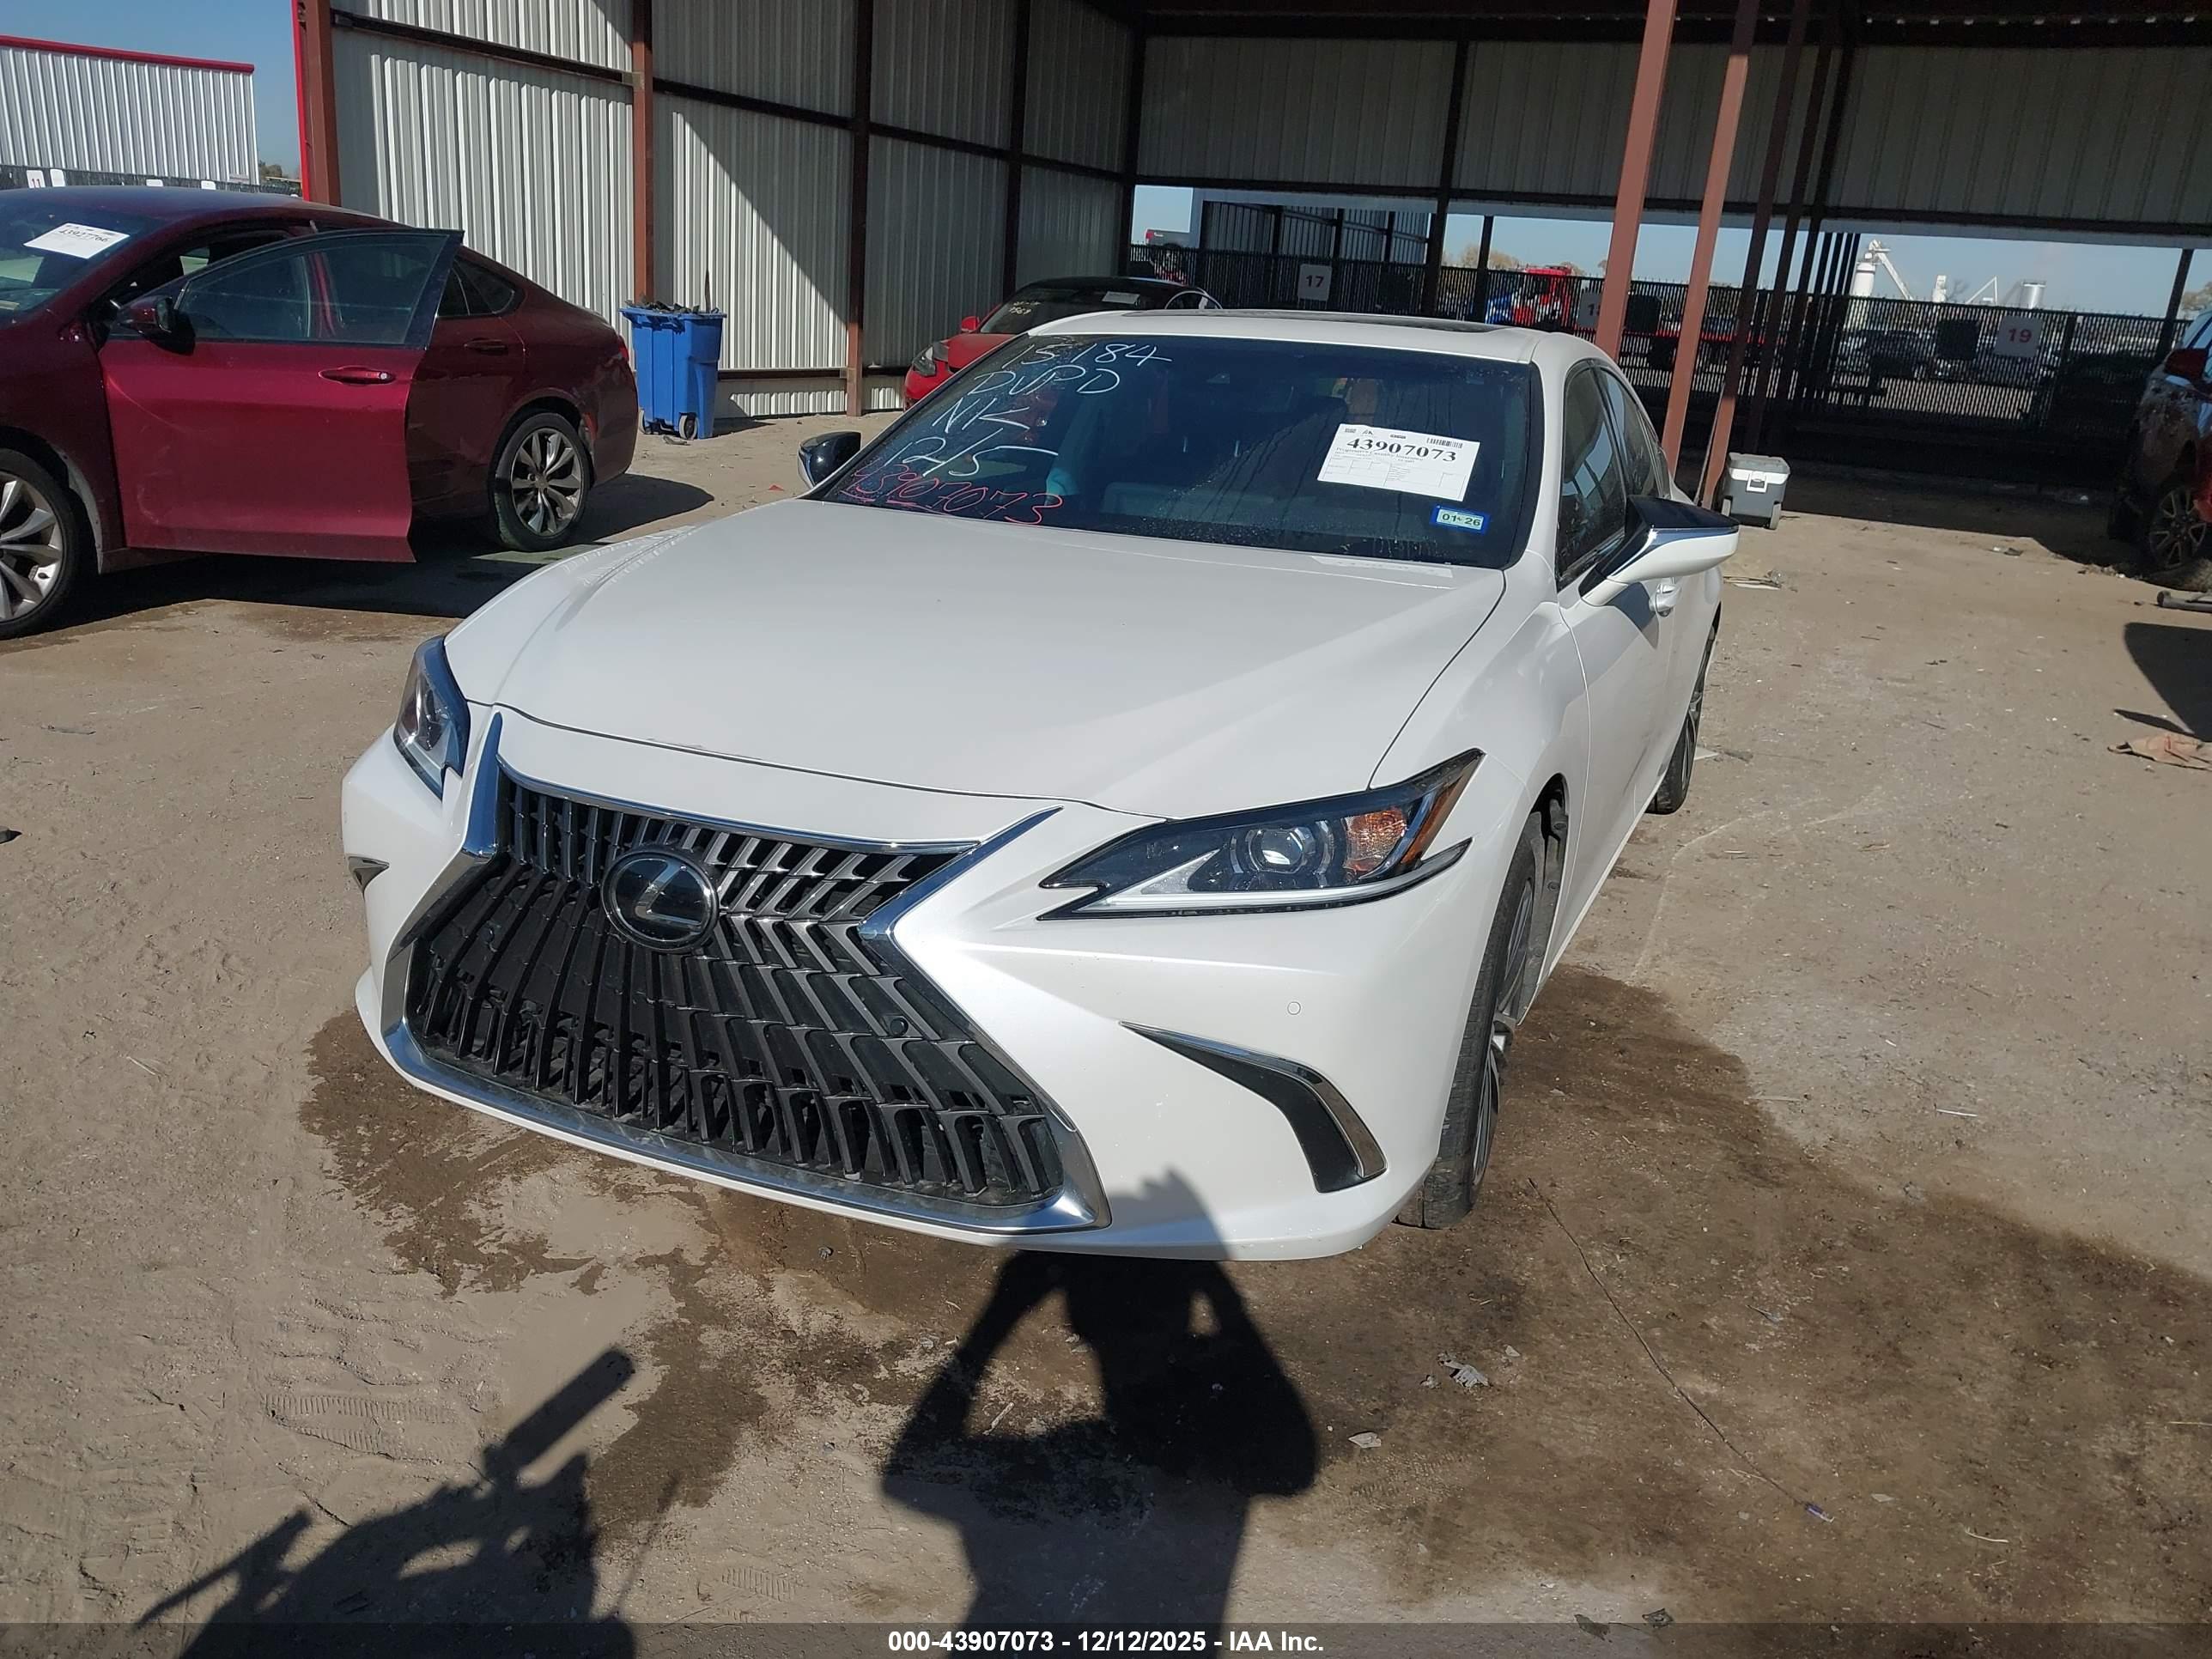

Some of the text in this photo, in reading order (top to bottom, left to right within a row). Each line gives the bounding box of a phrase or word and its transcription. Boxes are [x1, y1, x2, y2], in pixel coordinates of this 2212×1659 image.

[1305, 275, 1324, 288] 17
[2008, 328, 2032, 343] 19
[1346, 438, 1457, 463] 43907073
